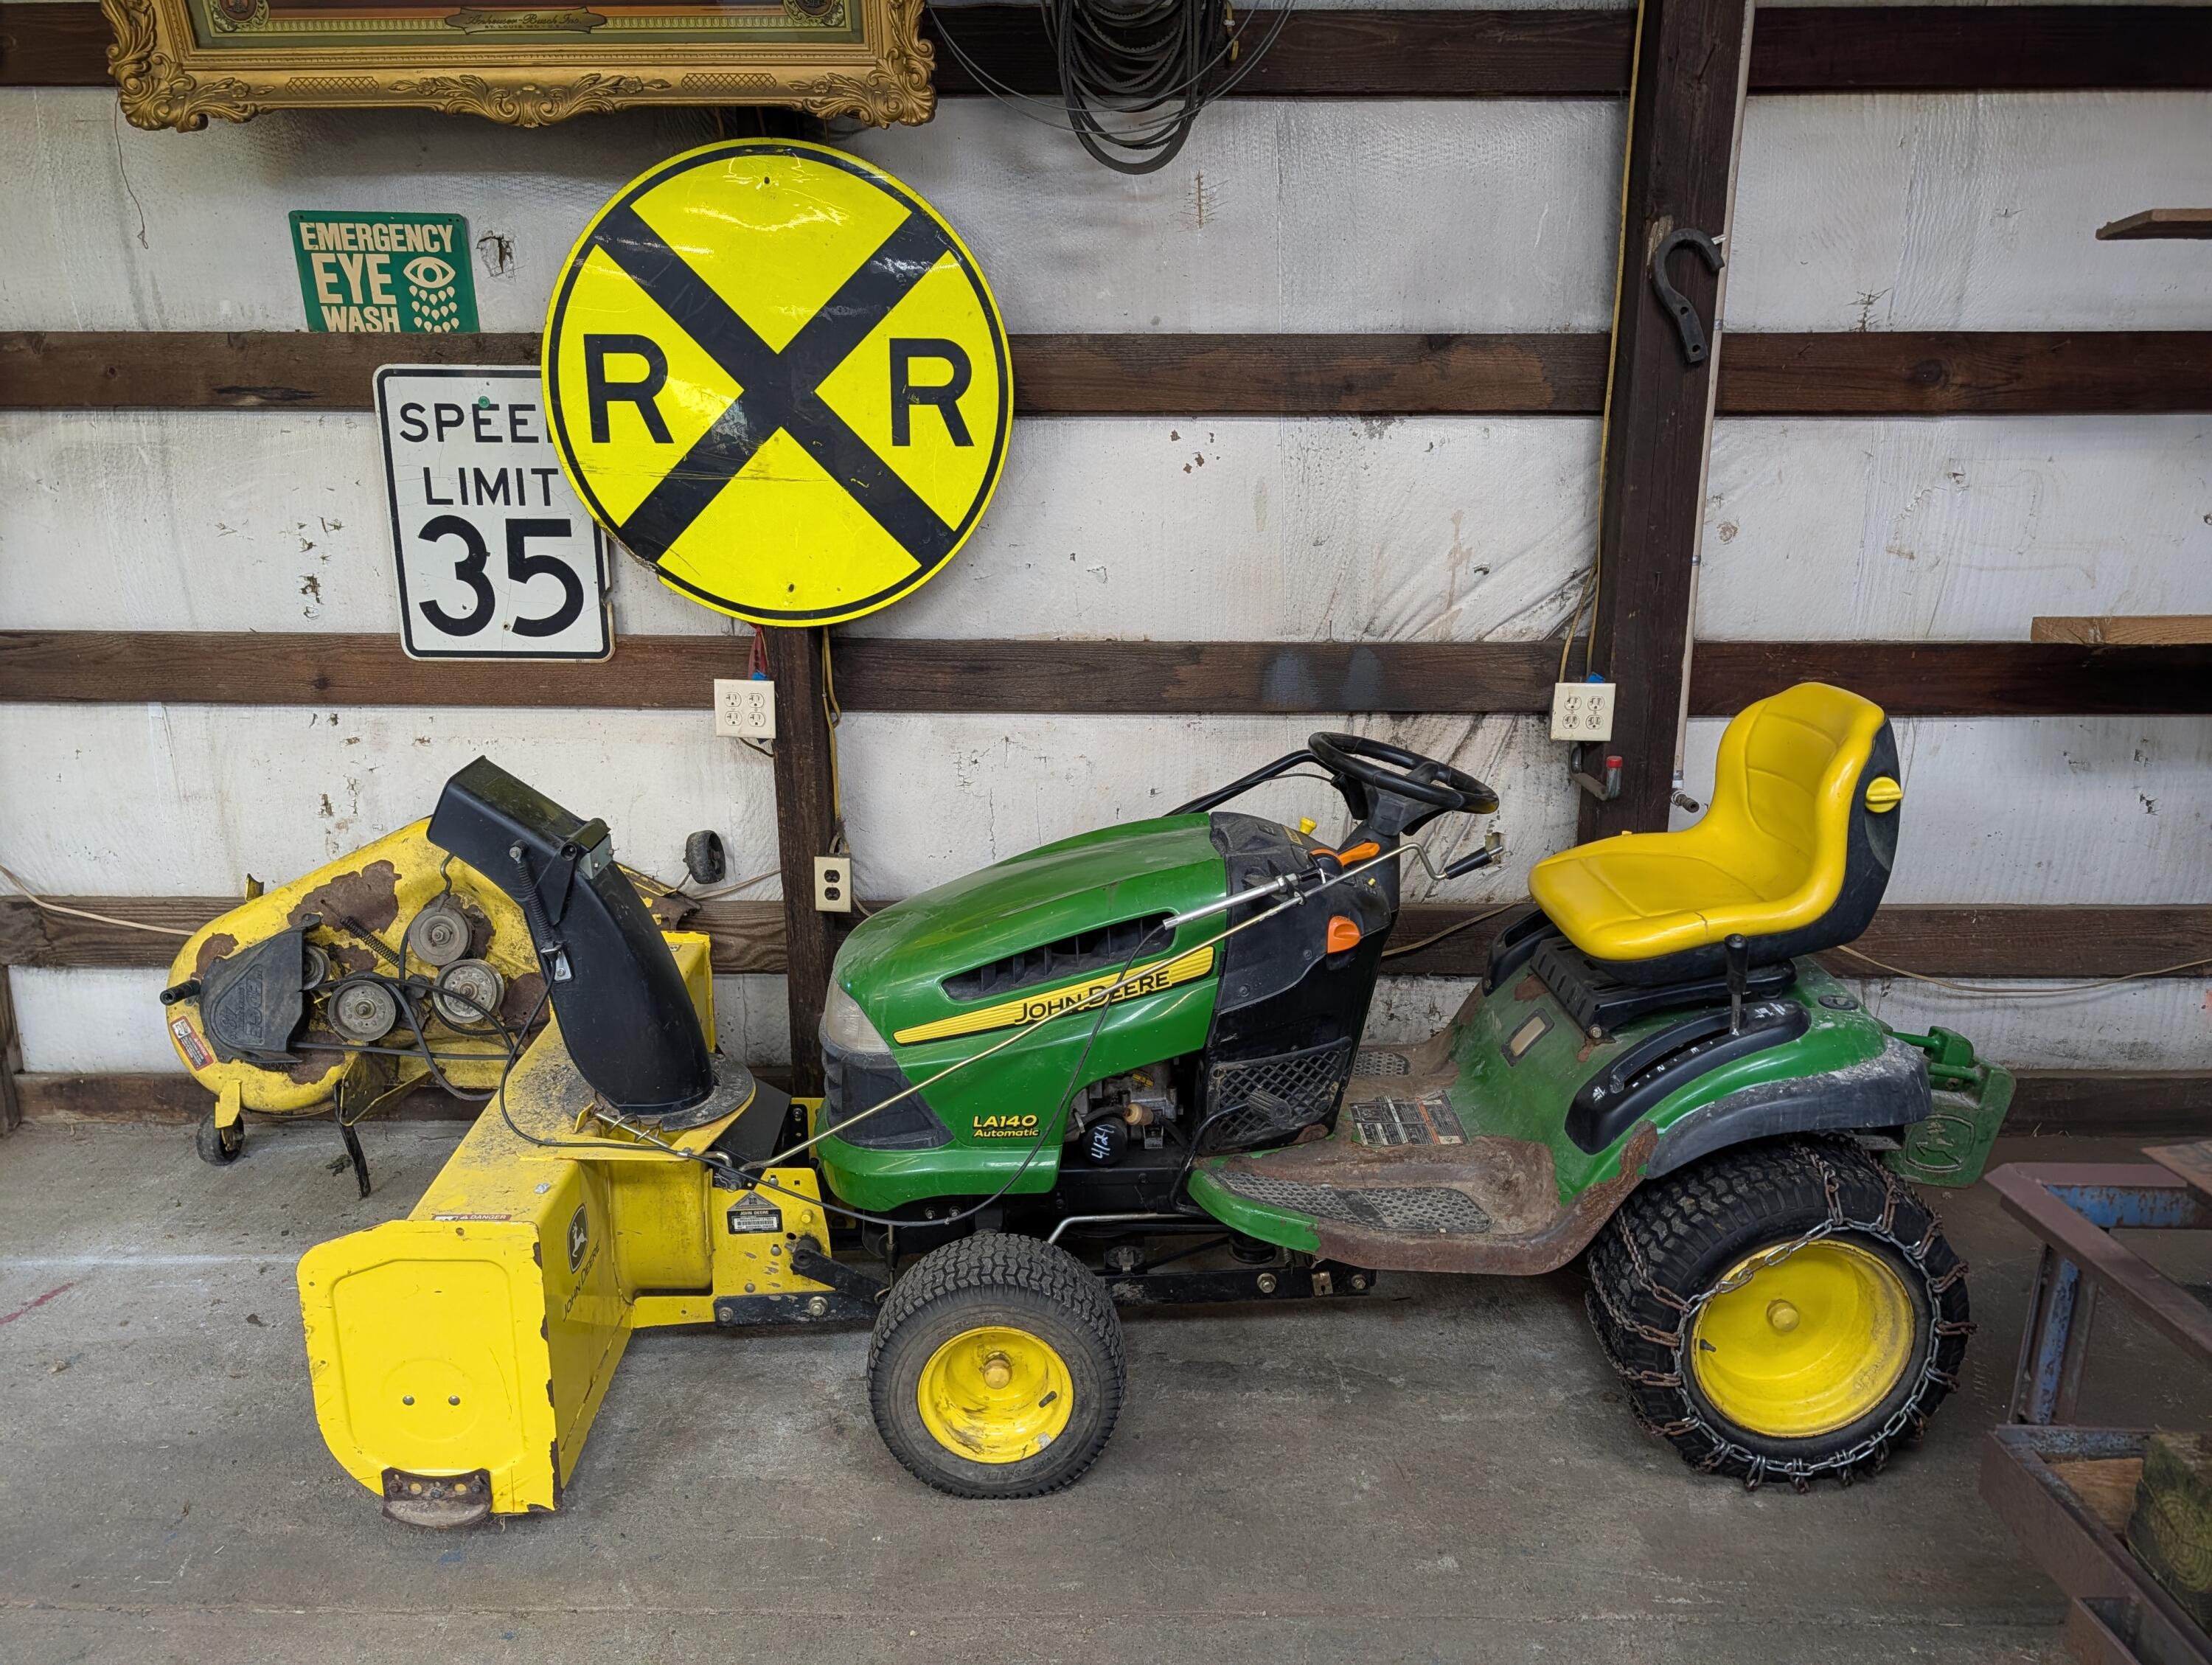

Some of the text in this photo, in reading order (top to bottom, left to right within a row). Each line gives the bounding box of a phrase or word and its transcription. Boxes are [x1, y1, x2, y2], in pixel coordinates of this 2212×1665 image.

[299, 222, 453, 252] EMERGENCY
[311, 253, 397, 305] EYE
[321, 305, 401, 333] WASH
[583, 333, 674, 443] R
[889, 338, 975, 447] R
[400, 402, 554, 443] SPEE
[423, 467, 559, 507] LIMIT
[417, 515, 584, 637] 35
[973, 1114, 1038, 1128] LA140
[973, 1128, 1040, 1137] Automatic
[563, 1240, 600, 1322] JOHN DEERE
